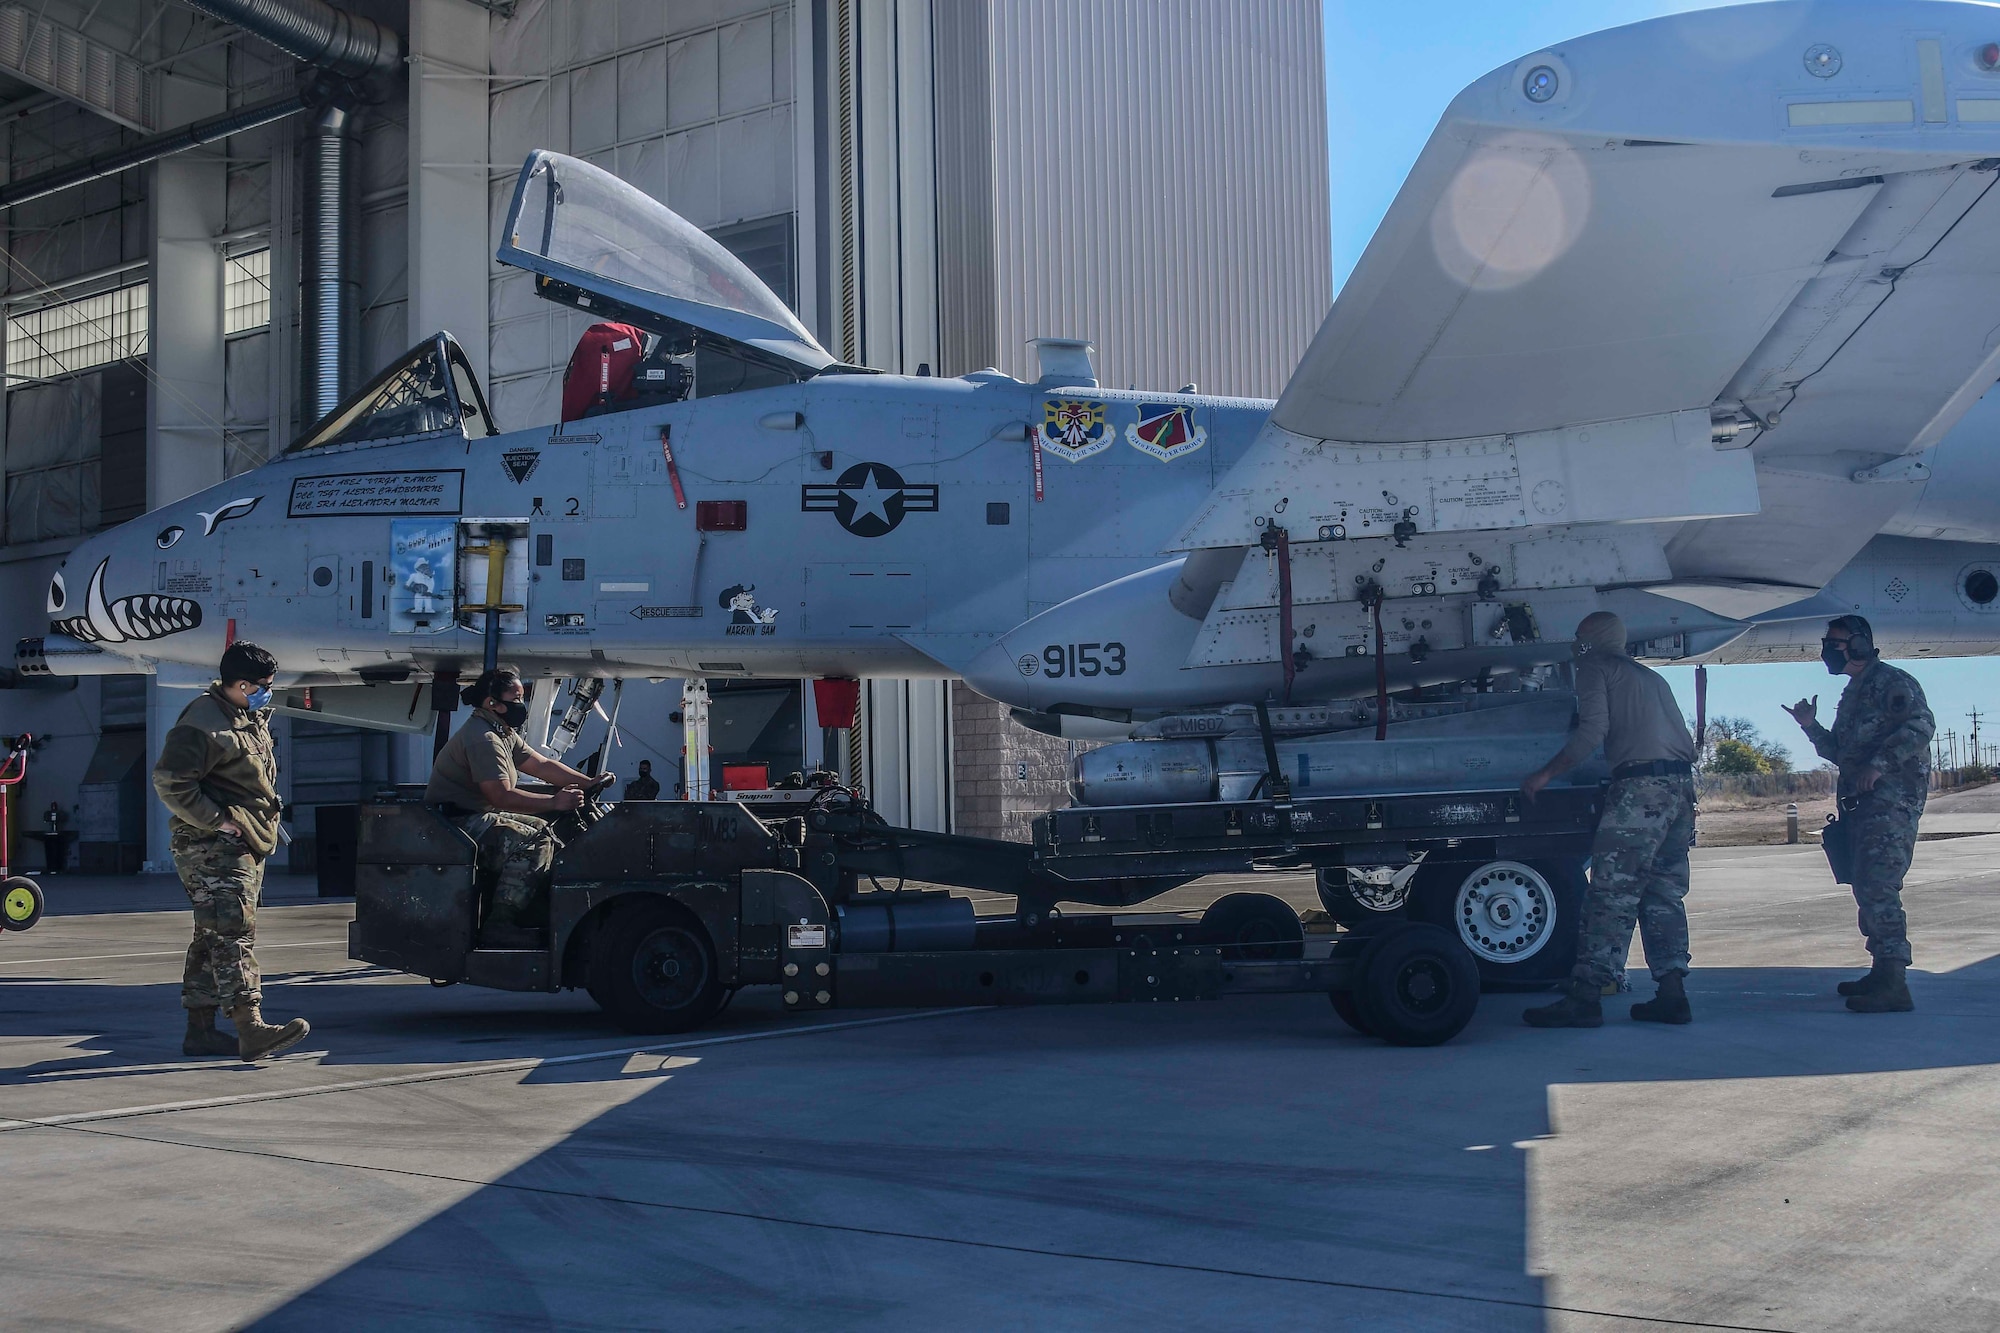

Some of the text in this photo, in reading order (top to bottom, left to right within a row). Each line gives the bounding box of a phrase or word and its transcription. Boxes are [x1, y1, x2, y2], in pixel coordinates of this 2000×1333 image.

[1053, 446, 1087, 459] FIGHTER
[1089, 438, 1108, 452] WING
[1145, 445, 1178, 458] FIGHTER
[1179, 437, 1202, 452] GROUP
[500, 460, 515, 483] DANGER
[524, 459, 541, 482] DANGER
[317, 479, 334, 488] COL
[338, 478, 361, 486] ABEL
[403, 475, 438, 484] RAMOS
[318, 489, 340, 498] TSGT
[342, 487, 376, 496] ALEXIS
[378, 485, 444, 495] CHADBOURNE
[316, 500, 336, 509] SRA
[339, 498, 396, 507] ALEXANDRA
[400, 497, 440, 506] MOLNAR
[640, 608, 671, 616] RESCUE
[761, 625, 776, 636] SAM
[1043, 642, 1127, 679] 9153
[735, 792, 773, 800] Snap-on
